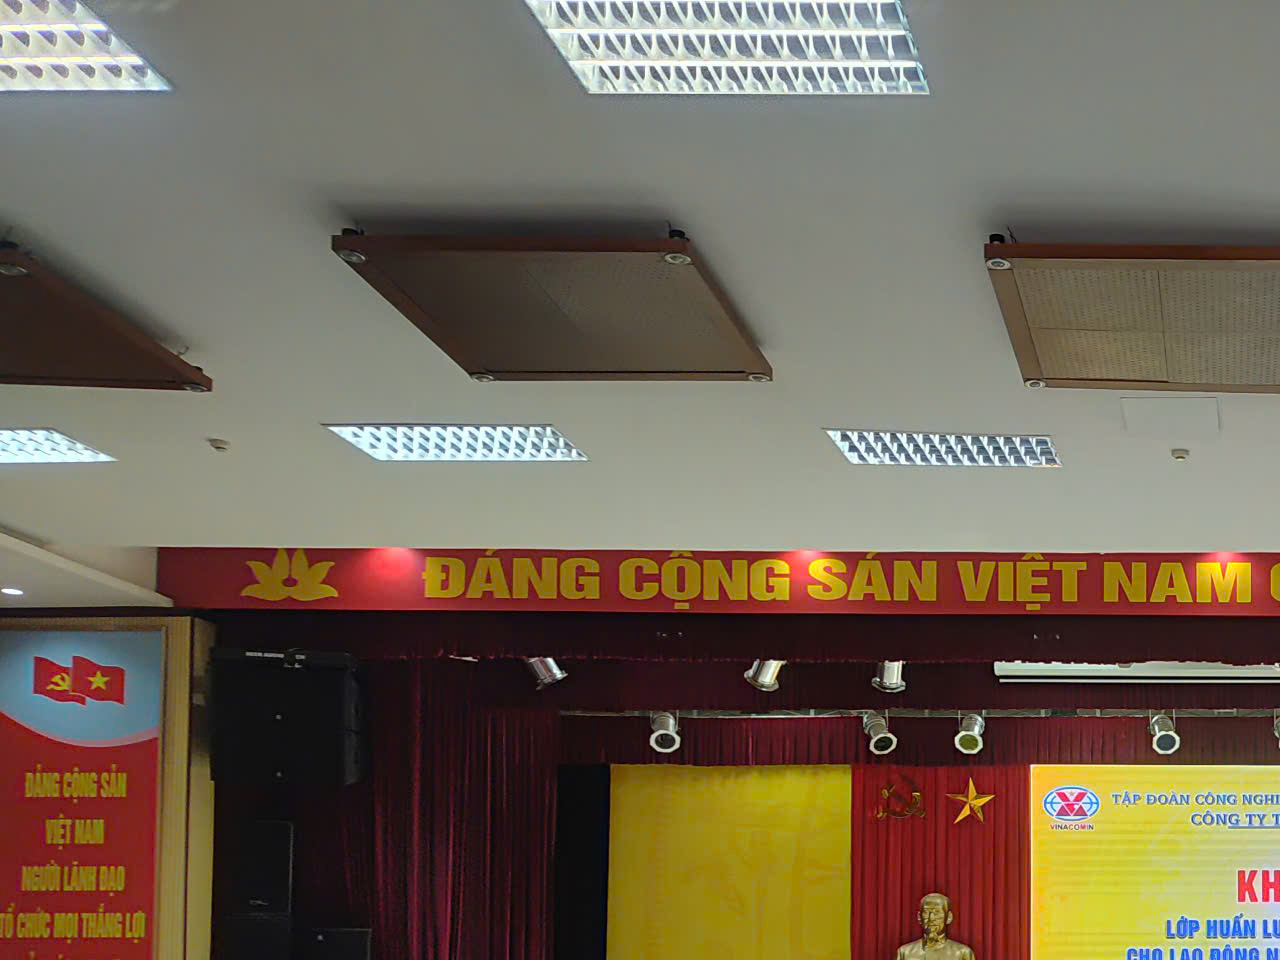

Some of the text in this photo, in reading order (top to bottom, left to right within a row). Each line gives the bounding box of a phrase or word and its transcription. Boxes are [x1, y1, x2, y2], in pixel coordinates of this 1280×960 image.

[618, 550, 790, 609] CỘNG
[957, 552, 1087, 611] VIỆT
[1103, 561, 1252, 603] NAM
[1112, 791, 1140, 808] TẬP
[1146, 791, 1190, 805] ĐOÀN
[1195, 791, 1237, 805] CÔNG
[1050, 823, 1094, 831] VINACOMIN
[1191, 810, 1241, 826] CÔNG
[1245, 814, 1267, 825] TY
[45, 813, 105, 850] VIỆT NAM
[1166, 915, 1200, 939] LỚP
[1206, 913, 1256, 939] HUẤN
